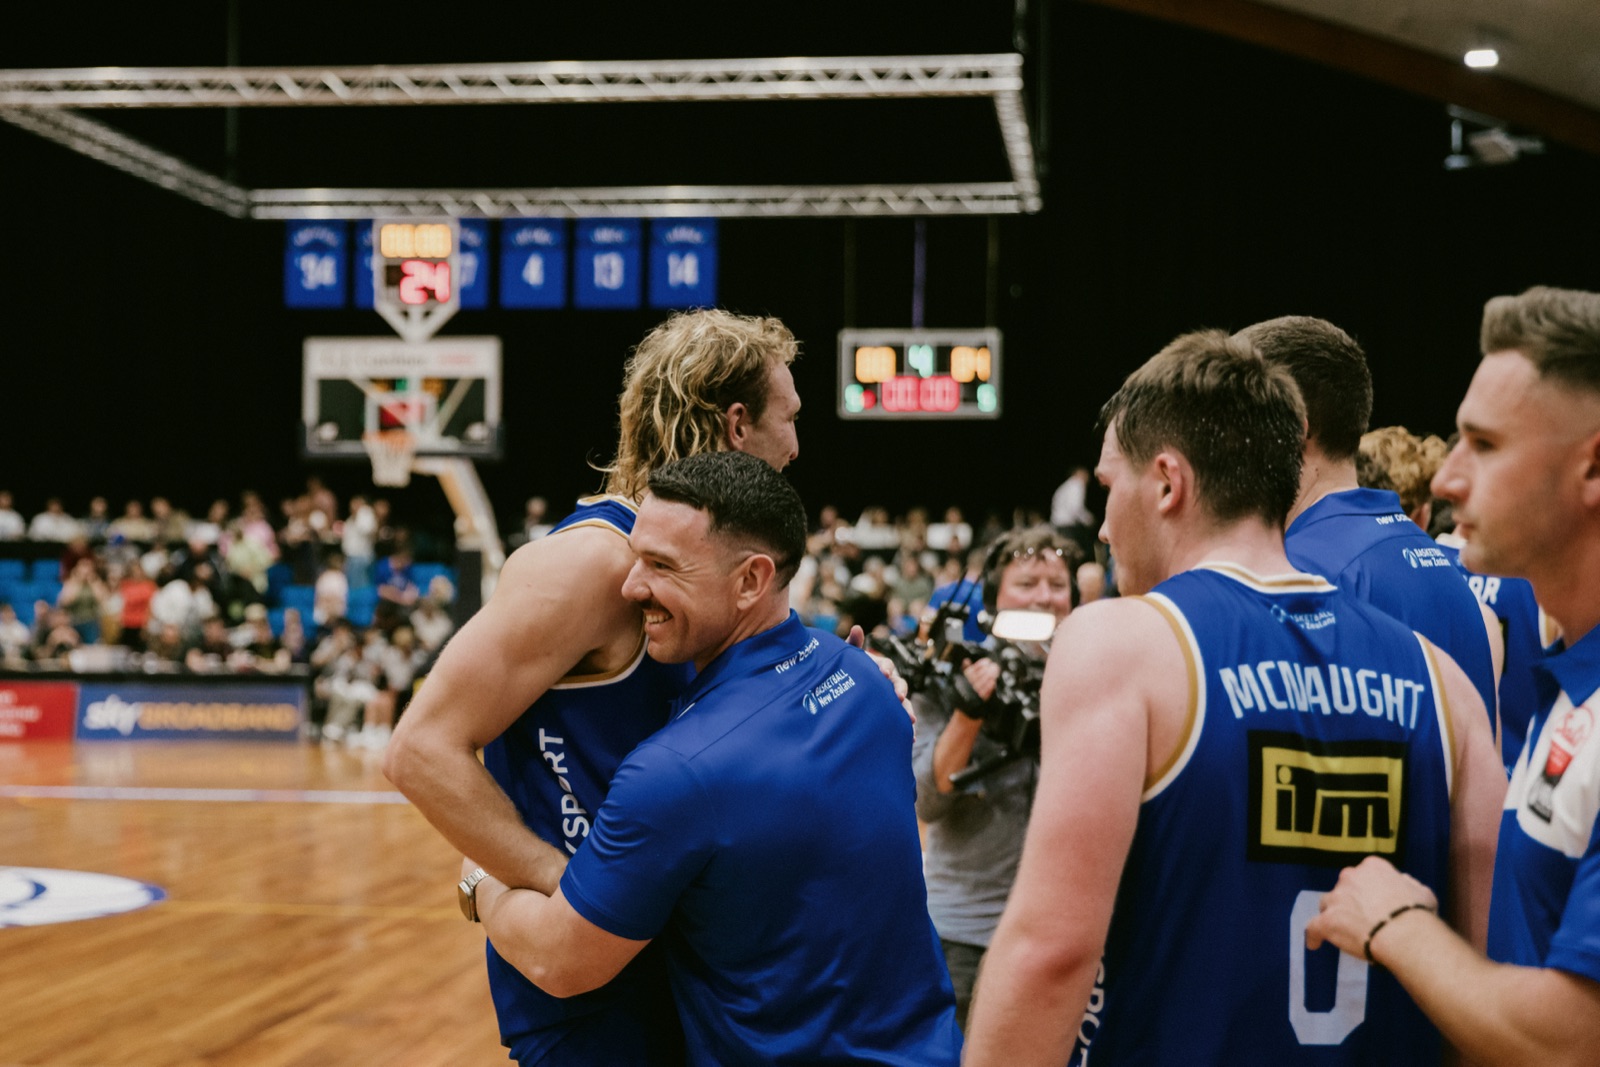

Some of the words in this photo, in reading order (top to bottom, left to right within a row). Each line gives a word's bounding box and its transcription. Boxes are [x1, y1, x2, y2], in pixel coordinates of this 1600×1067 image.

[399, 259, 452, 304] 24
[522, 252, 545, 287] 4
[667, 252, 700, 288] 14
[908, 344, 933, 378] 4
[775, 654, 798, 675] new
[818, 692, 834, 709] New
[829, 675, 857, 700] Zealand
[1218, 660, 1425, 730] MCNAUGHT
[82, 693, 139, 736] sky
